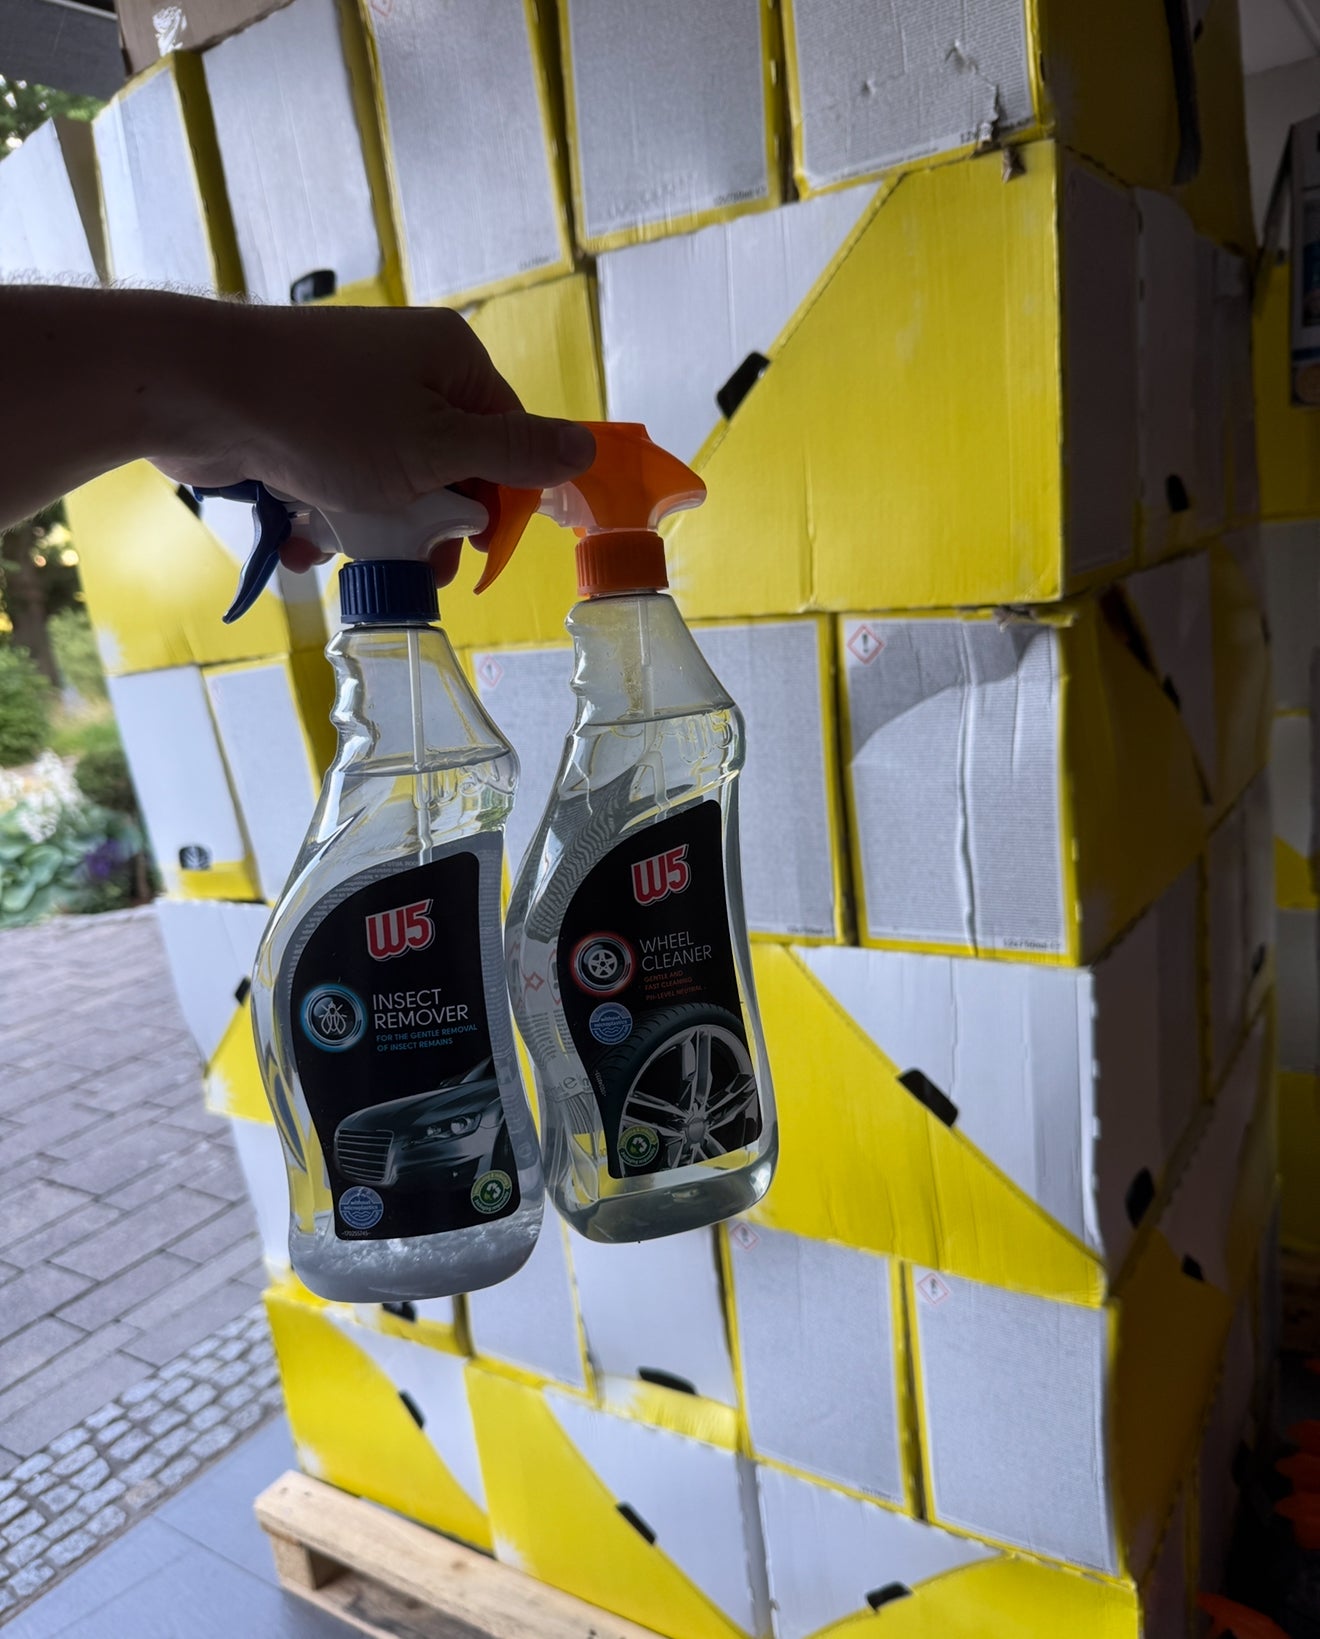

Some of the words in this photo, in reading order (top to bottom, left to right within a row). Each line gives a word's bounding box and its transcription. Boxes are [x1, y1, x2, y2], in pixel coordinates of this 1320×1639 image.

[631, 843, 692, 905] W5
[365, 898, 435, 961] W5
[640, 931, 695, 953] WHEEL
[641, 945, 712, 971] CLEANER
[644, 974, 668, 983] GENTLE
[669, 970, 684, 978] AND
[661, 977, 693, 988] CLEANING
[373, 989, 442, 1011] INSECT
[375, 1005, 469, 1029] REMOVER
[375, 1034, 393, 1042] FOR
[394, 1032, 409, 1041] THE
[410, 1029, 440, 1039] GENTLE
[441, 1024, 478, 1036] REMOVAL
[376, 1044, 389, 1053] OF
[390, 1042, 417, 1051] INSECT
[419, 1038, 453, 1048] REMAINS
